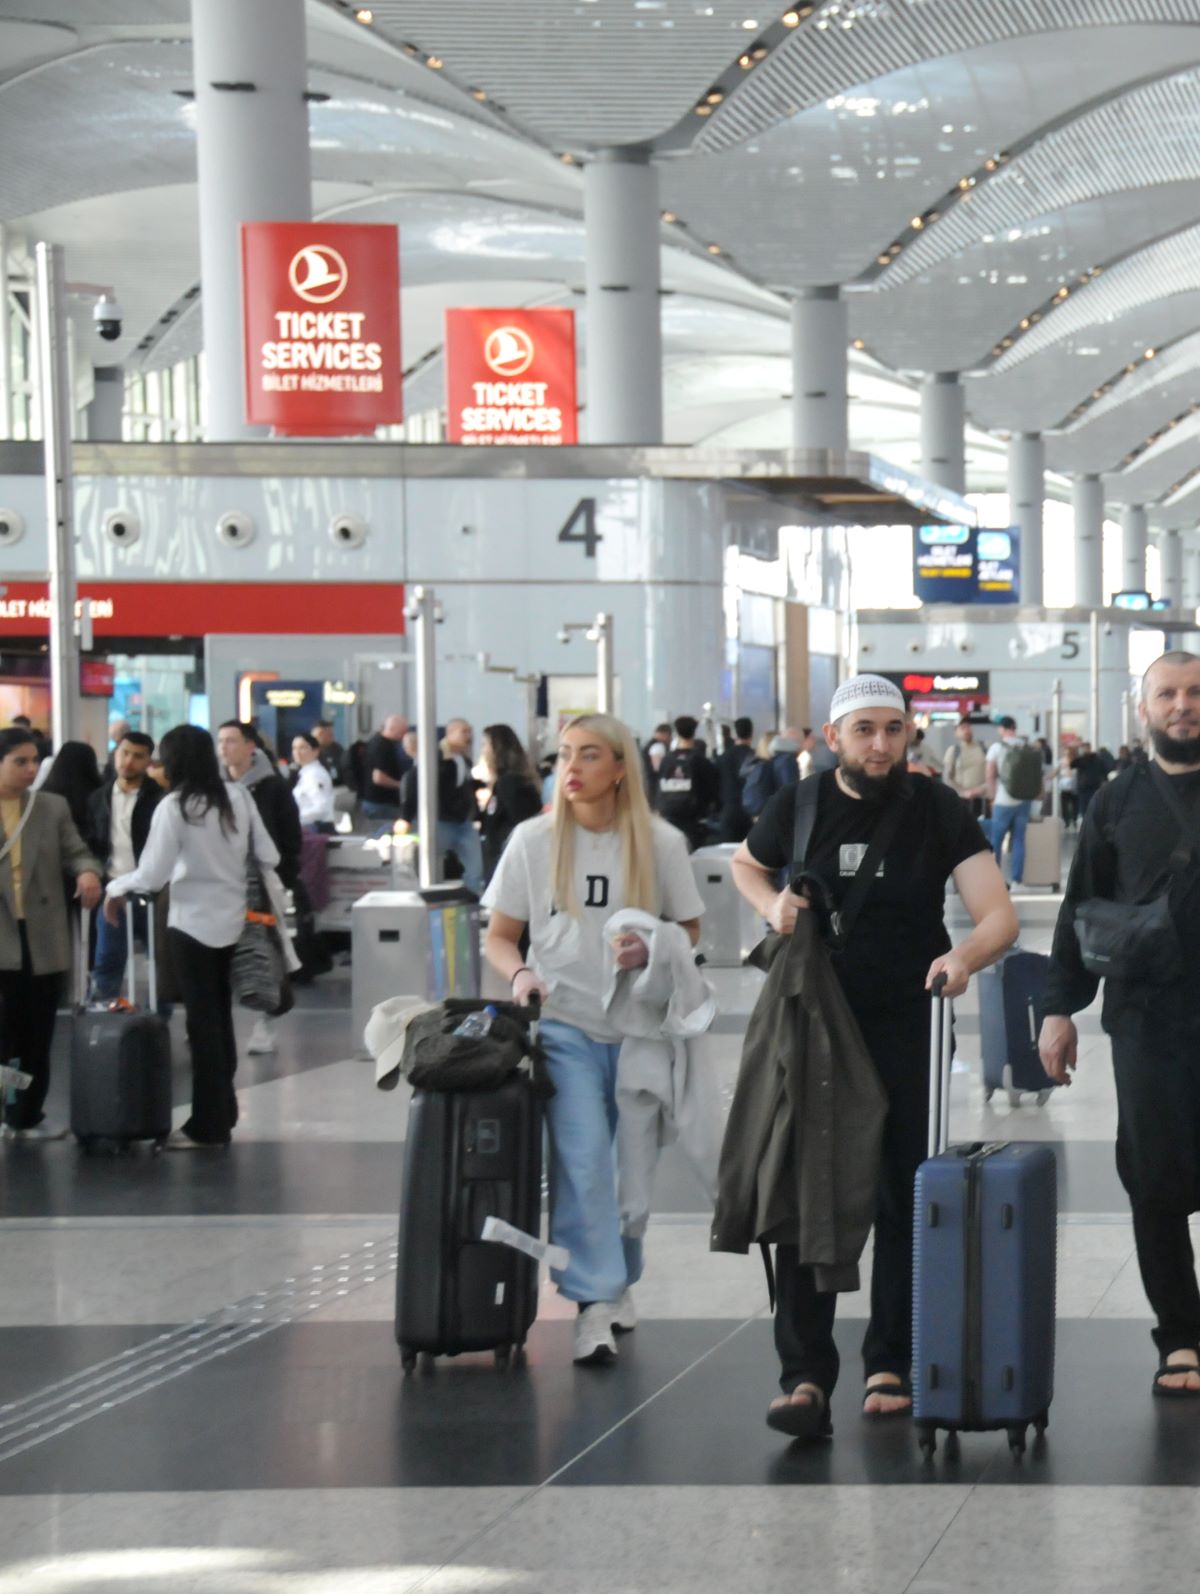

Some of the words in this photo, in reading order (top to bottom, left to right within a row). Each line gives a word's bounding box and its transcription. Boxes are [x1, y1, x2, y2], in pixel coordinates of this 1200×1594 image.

[275, 312, 365, 339] TICKET
[261, 342, 382, 370] SERVICES
[262, 372, 299, 391] BİLET
[301, 371, 383, 392] HİZMETLERİ
[472, 382, 548, 405] TICKET
[461, 407, 562, 431] SERVICES
[558, 498, 603, 558] 4
[1061, 631, 1080, 659] 5
[584, 874, 609, 908] D
